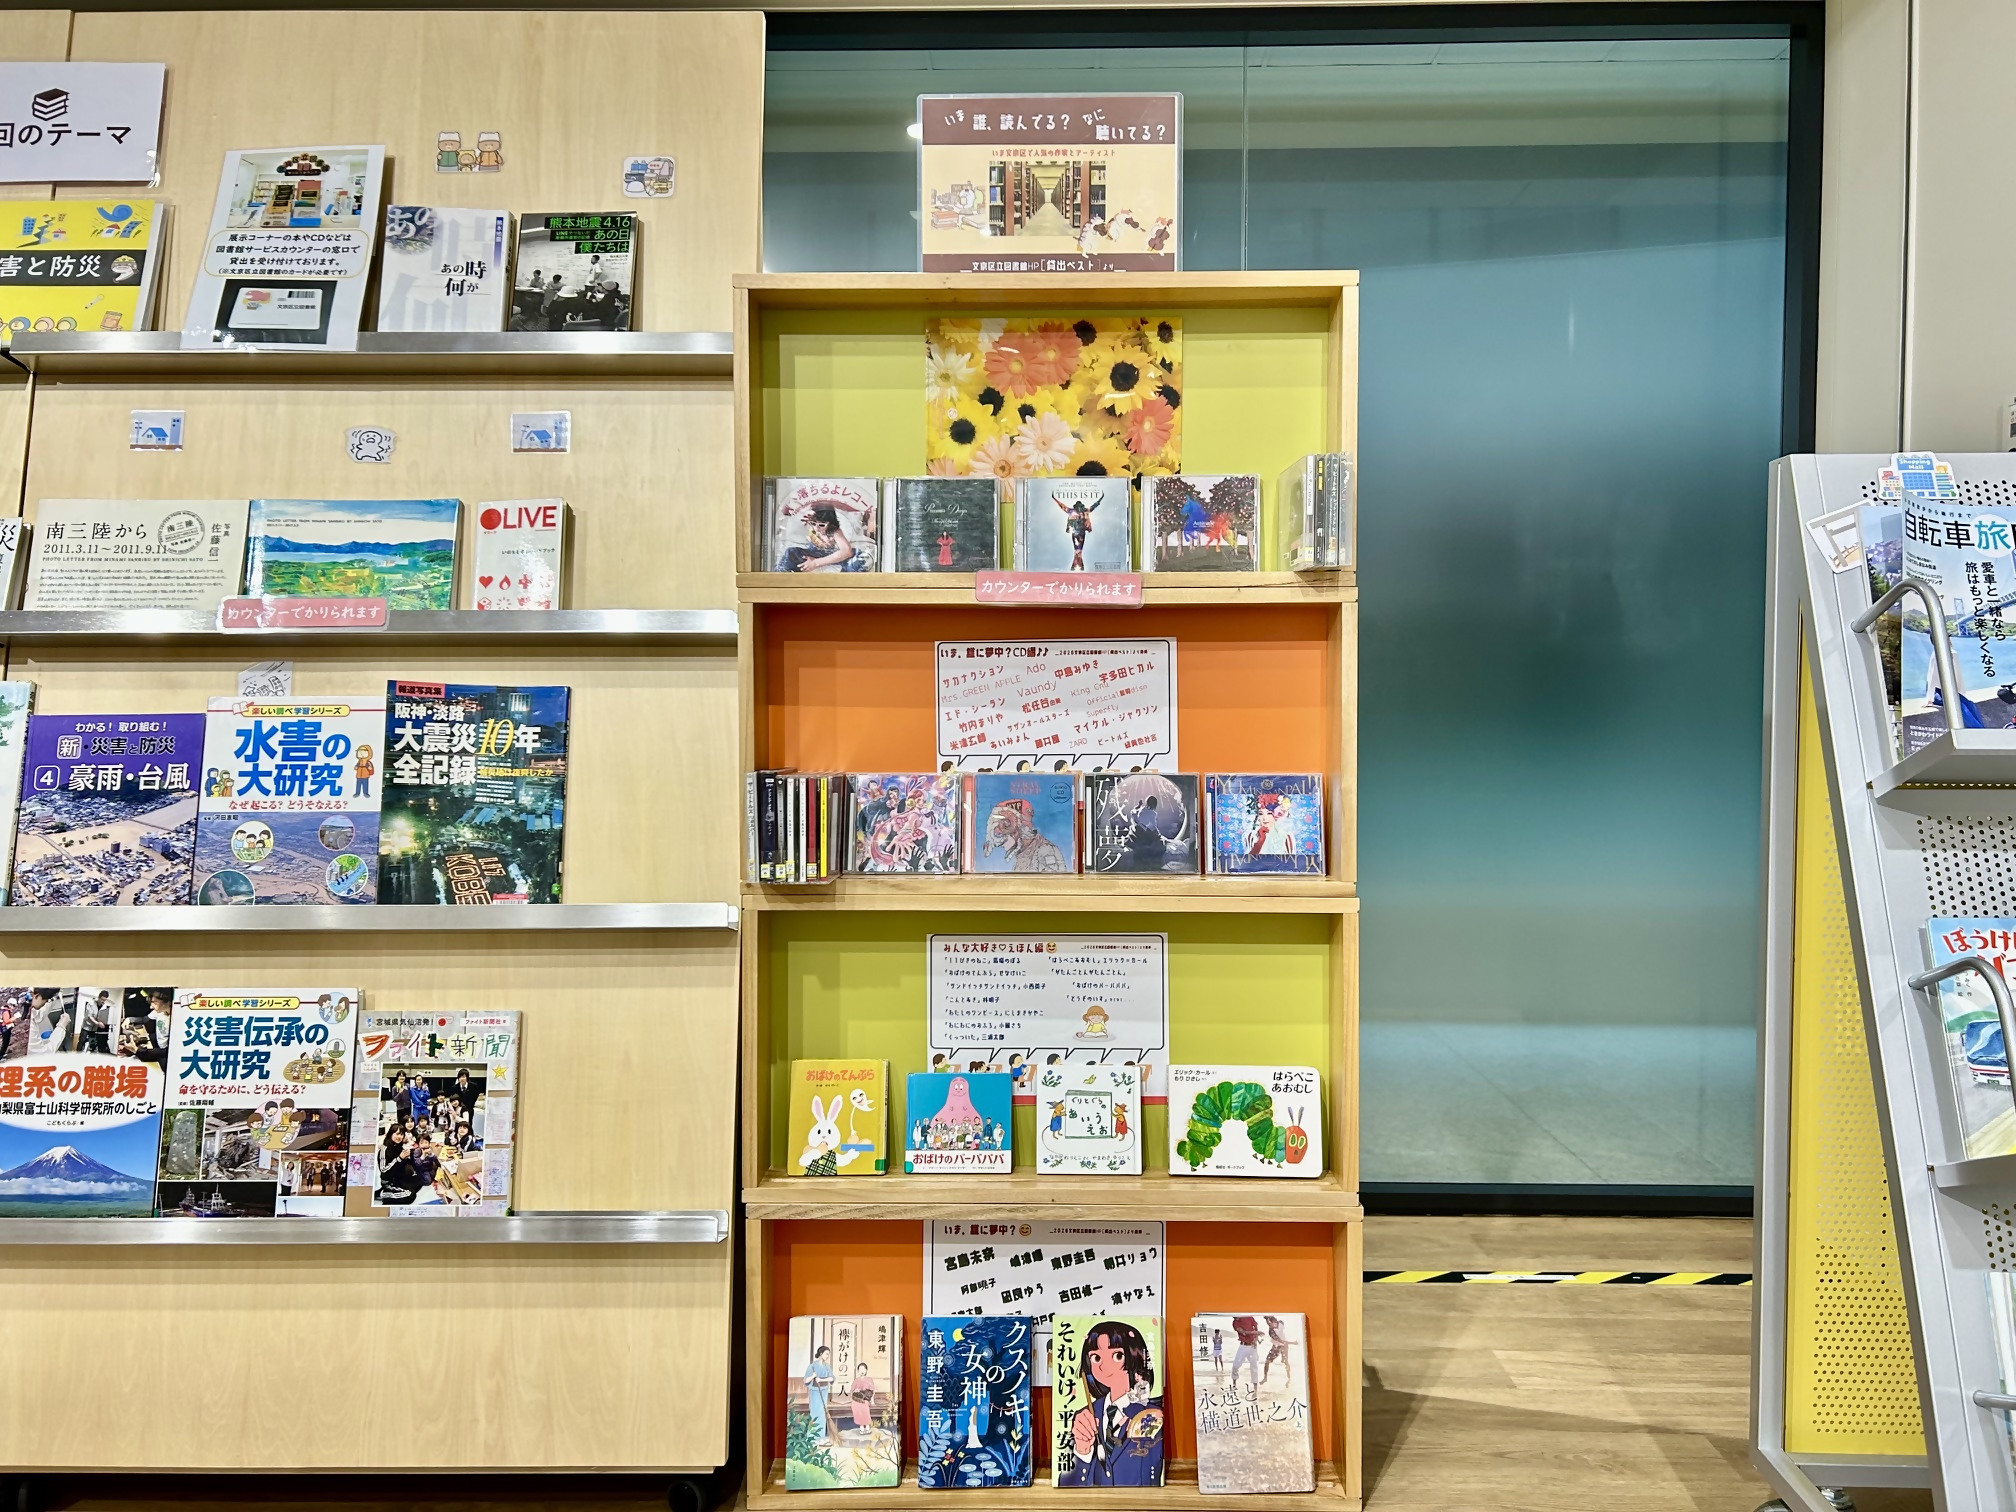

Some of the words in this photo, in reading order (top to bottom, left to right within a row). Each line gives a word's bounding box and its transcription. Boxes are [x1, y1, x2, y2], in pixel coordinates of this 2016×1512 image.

[945, 110, 965, 126] いま
[1083, 109, 1106, 126] なに
[1096, 124, 1166, 141] 聴いてる？
[228, 233, 352, 242] 展示コーナーの本やCDなどは
[594, 229, 629, 240] あの日
[215, 245, 361, 254] 図書館サービスカウンターの窓口で
[580, 241, 629, 253] 僕たちは
[229, 257, 340, 266] 貸出を受け付けております。
[441, 260, 487, 279] あの時
[444, 277, 479, 297] 何が
[1898, 459, 1931, 467] Shopping
[46, 521, 148, 541] 南三陸から
[1905, 507, 2016, 549] 自転車旅
[981, 580, 1136, 597] カウンターでかりられます
[1981, 561, 2006, 642] 愛車と一緒なら
[1965, 561, 1996, 678] 旅はもっと楽しくなる
[943, 665, 1004, 688] サカナクション
[1026, 663, 1046, 675] Ado
[1055, 660, 1099, 679] 中島みゆき
[1099, 661, 1154, 683] 宇多田ヒカル
[398, 685, 442, 696] 報道写真集
[995, 675, 1022, 688] APPLE
[1017, 680, 1057, 698] Vaundy
[251, 706, 341, 716] 楽しい調べ学習シリーズ
[394, 702, 465, 721] 阪神・淡路
[945, 698, 1006, 721] エド・シーラン
[75, 722, 113, 732] わかる！
[118, 722, 167, 732] 取り組む！
[959, 713, 1003, 733] 竹内まりや
[1007, 709, 1070, 732] サザンオールスターズ
[1074, 705, 1158, 734] マイケル・ジャクソン
[234, 719, 351, 763] 水害の
[394, 718, 541, 756] 大震災10年
[990, 732, 1030, 749] あいみょん
[1098, 731, 1129, 746] ビートルズ
[39, 770, 54, 786] 4
[68, 763, 190, 791] 豪雨・台風
[393, 754, 477, 785] 全記録
[236, 763, 343, 797] 大研究
[229, 800, 283, 810] なぜ起こる？
[287, 800, 348, 810] どうそなえる？
[1942, 926, 2016, 954] ぼうけ
[199, 998, 292, 1008] 楽しい調べ学習シリーズ
[182, 1016, 329, 1047] 災害伝承の
[362, 1032, 511, 1059] ファイト新聞
[179, 1049, 271, 1080] 大研究
[806, 1069, 875, 1081] おばけのてんぷら
[1273, 1072, 1314, 1082] はらぺこ
[1271, 1083, 1313, 1094] あおむし
[0, 1101, 157, 1116] 梨県富士山科学研究所のしごと
[913, 1153, 1005, 1164] おばけのバーバパパ
[1198, 1323, 1209, 1362] 吉田修一
[926, 1330, 944, 1429] 東野圭吾
[959, 1342, 989, 1407] 女神
[985, 1365, 1005, 1384] の
[1002, 1320, 1029, 1424] クスノキ
[1056, 1320, 1076, 1472] それいけ！平安部
[1198, 1383, 1258, 1410] 永遠と
[1200, 1397, 1308, 1434] 横道世之介
